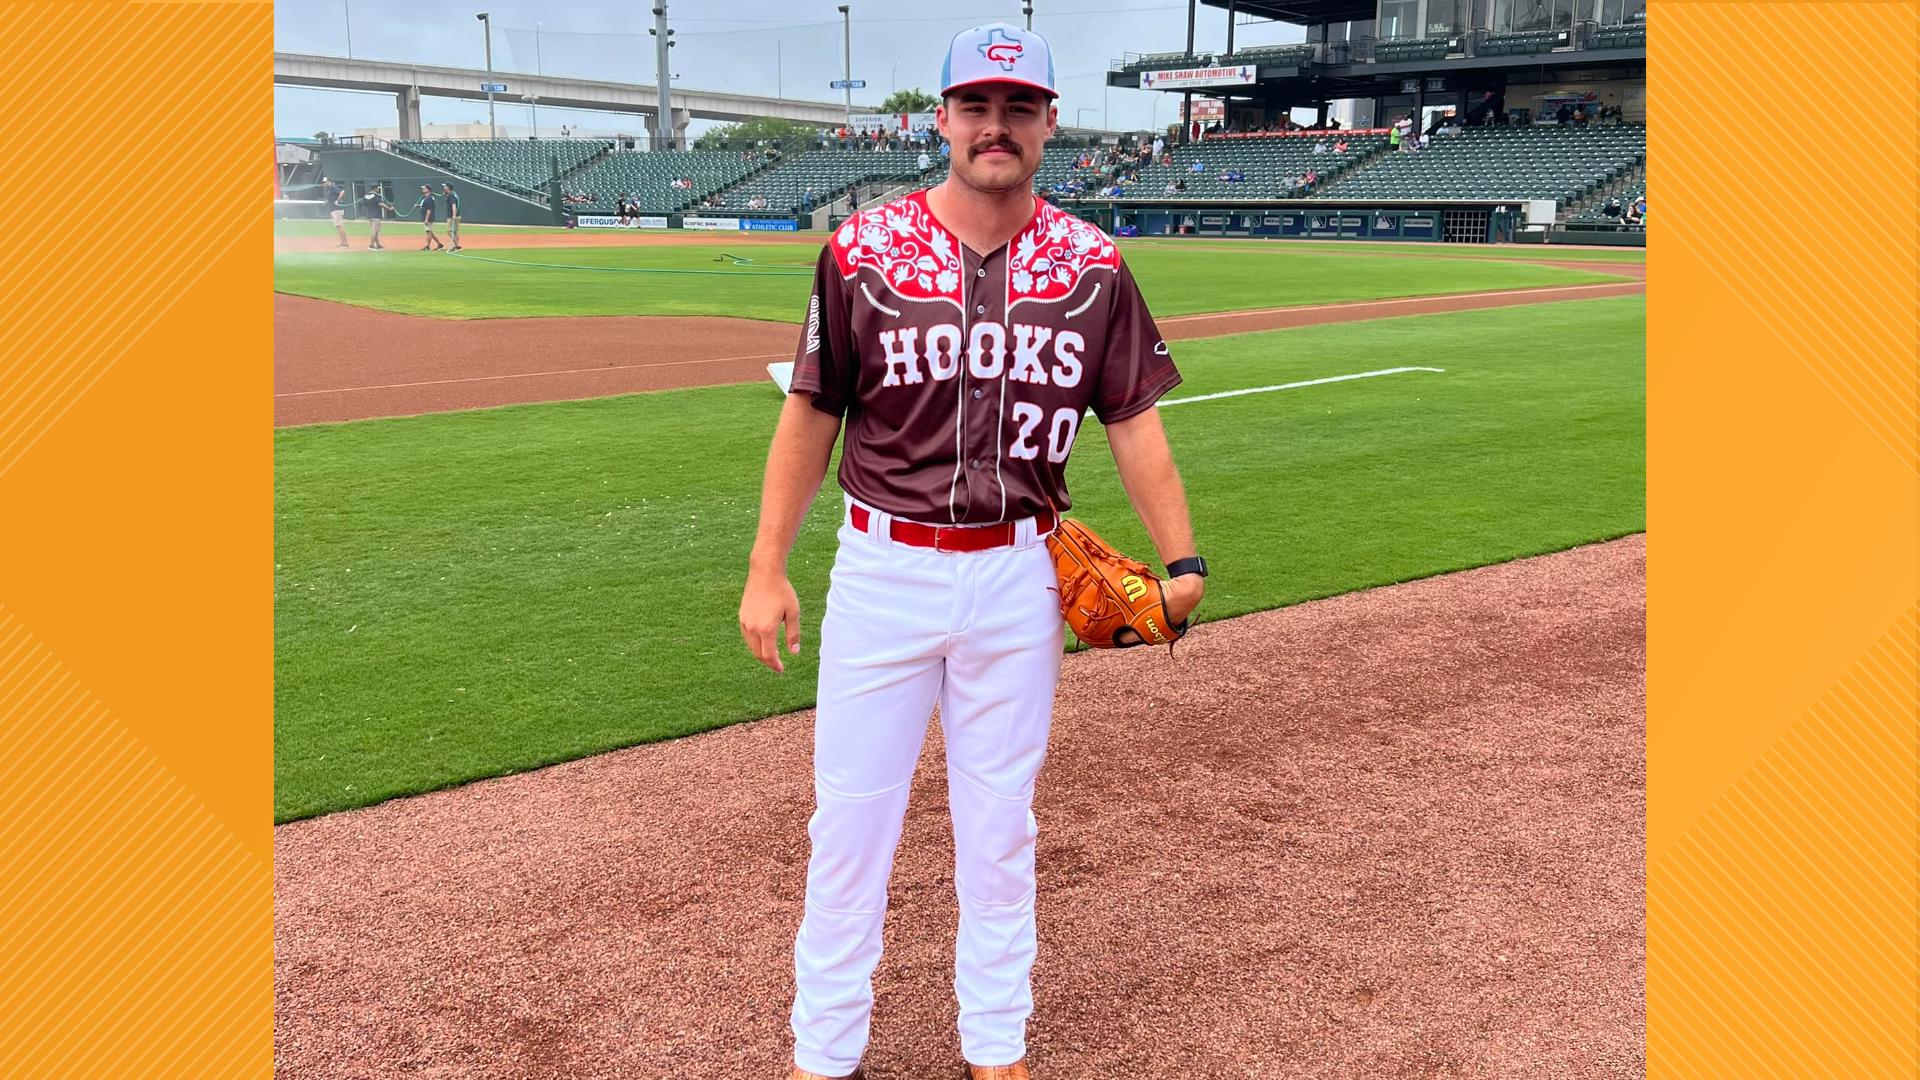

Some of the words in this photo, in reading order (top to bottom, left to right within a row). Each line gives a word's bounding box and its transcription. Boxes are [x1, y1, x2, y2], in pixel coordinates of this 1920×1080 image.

[1158, 72, 1173, 80] MIKE
[1175, 70, 1193, 79] SHAW
[1195, 68, 1237, 78] AUTOMOTIVE
[751, 223, 777, 231] ATHLETIC
[879, 322, 1085, 388] HOOKS
[1008, 401, 1079, 463] 20
